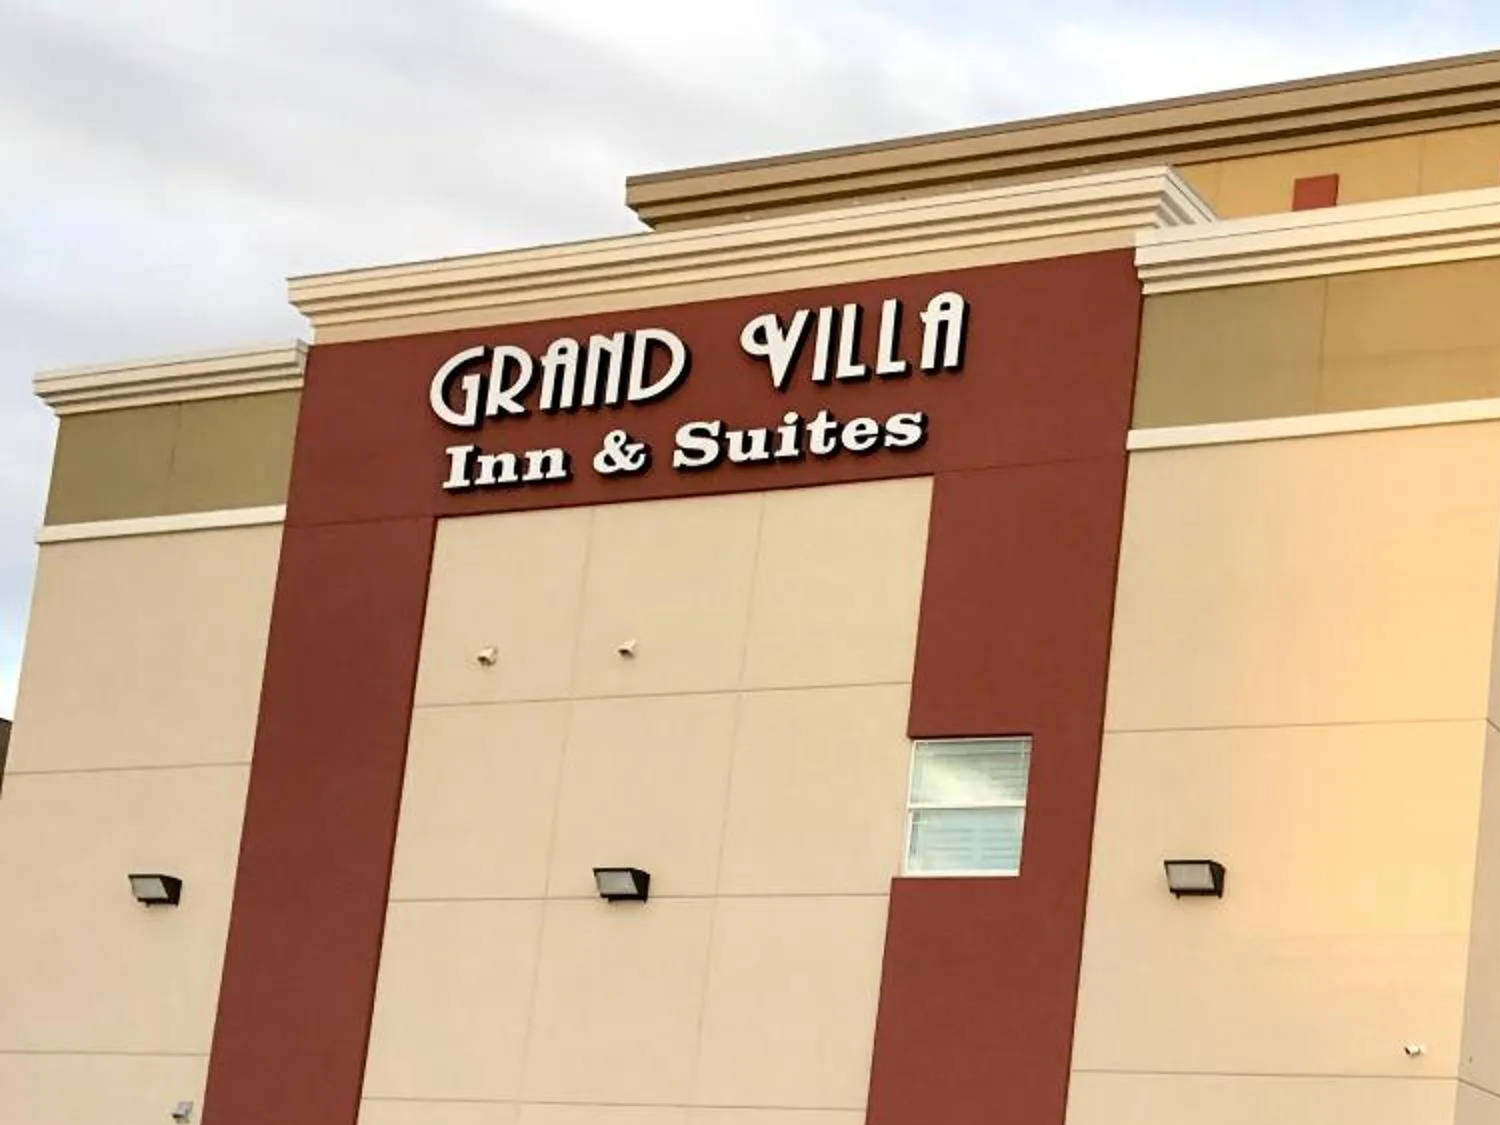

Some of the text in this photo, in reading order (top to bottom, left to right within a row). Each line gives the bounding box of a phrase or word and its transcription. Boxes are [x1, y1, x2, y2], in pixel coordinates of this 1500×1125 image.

[430, 292, 965, 426] GRAND VILLA
[442, 411, 923, 489] Inn & Suites
